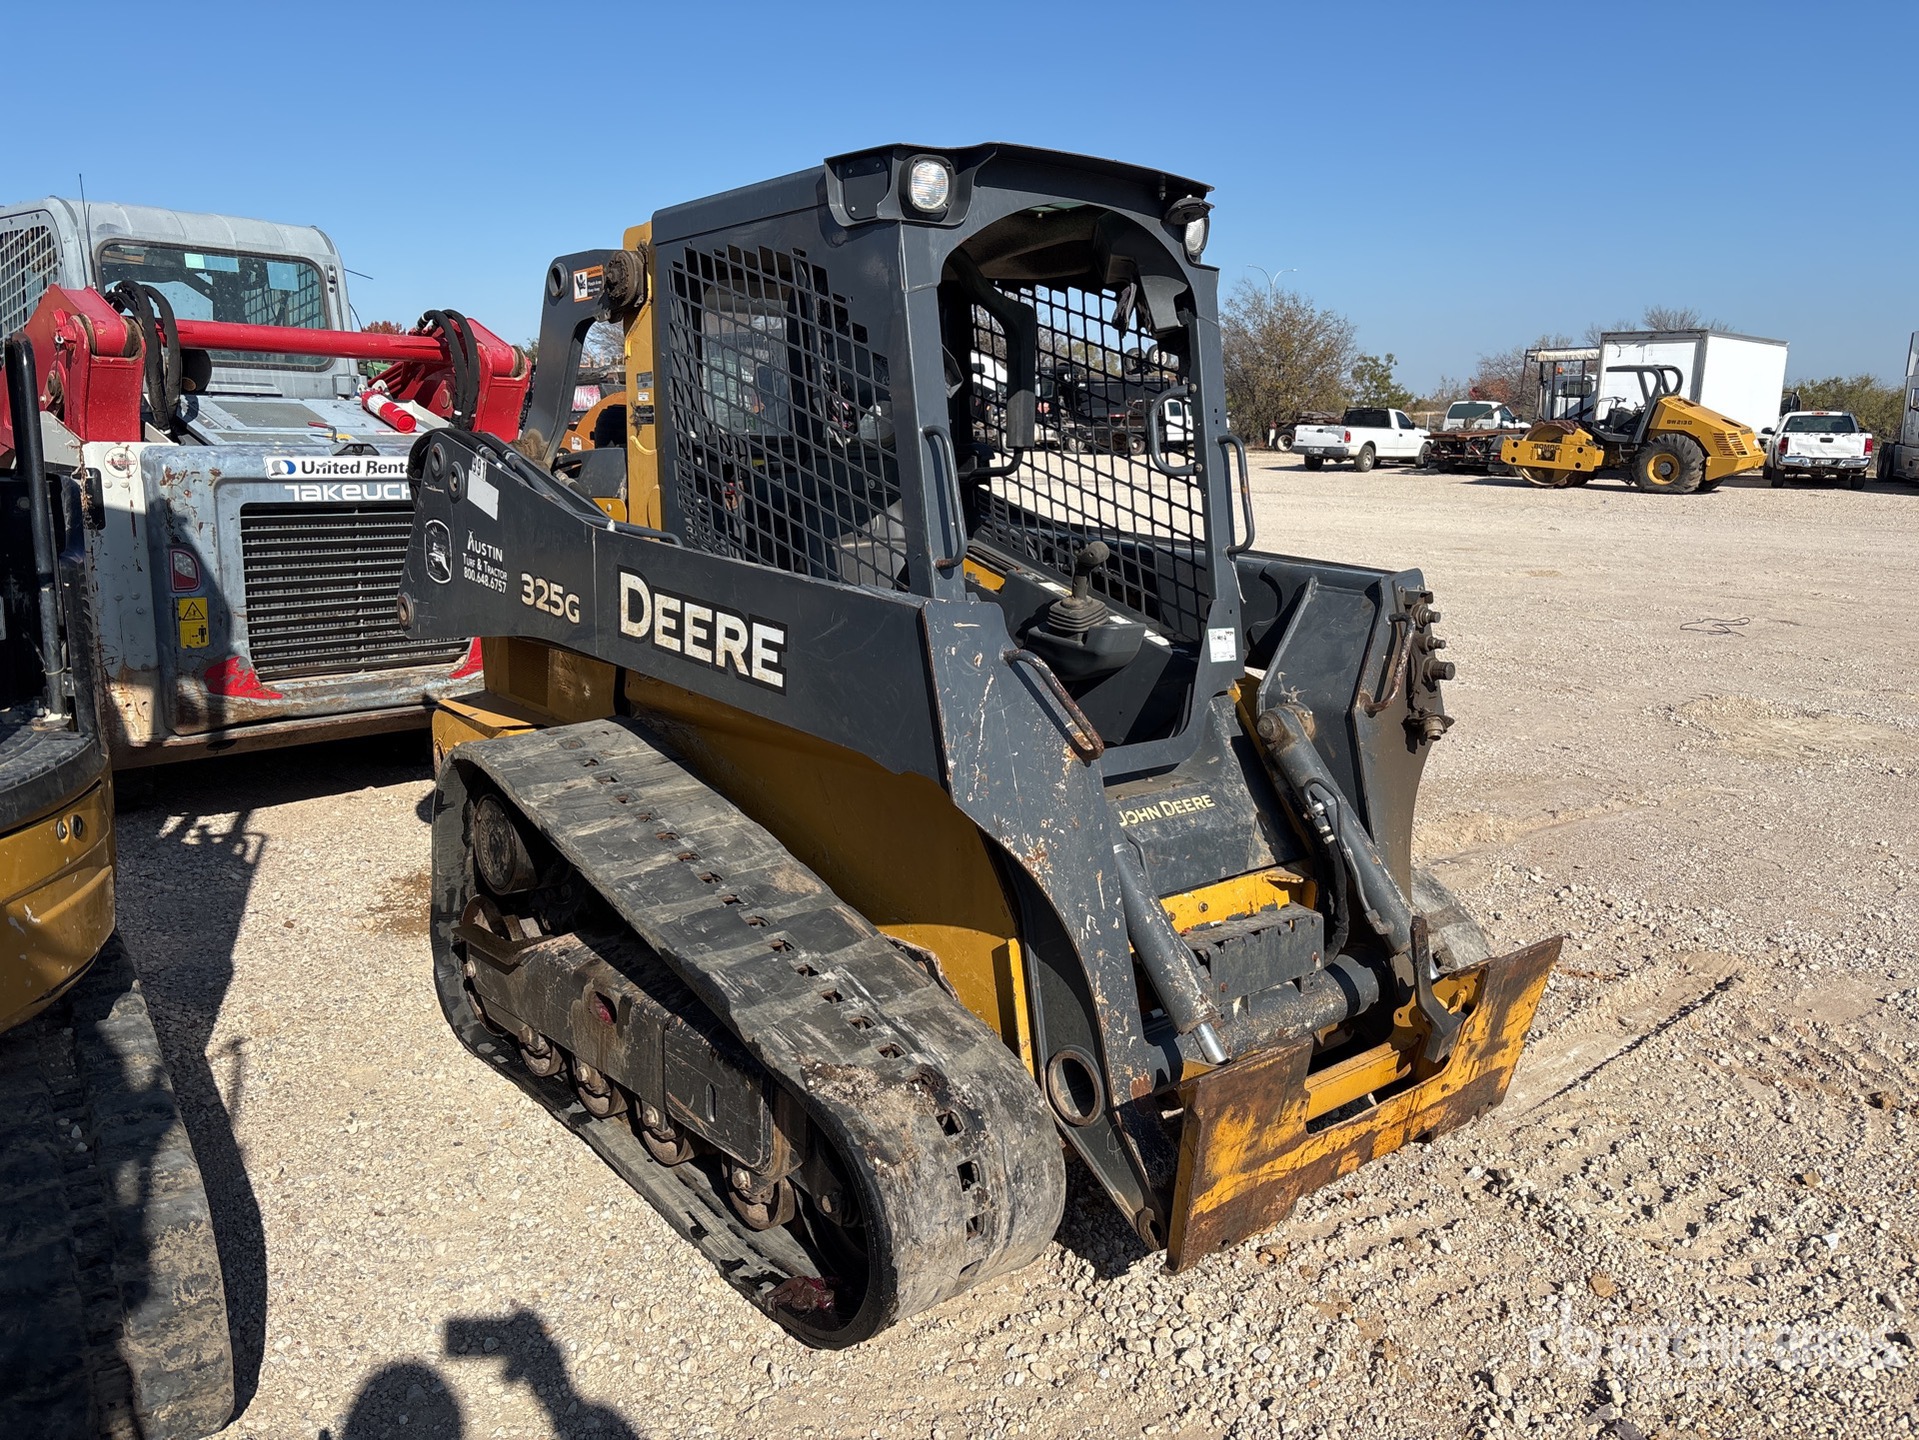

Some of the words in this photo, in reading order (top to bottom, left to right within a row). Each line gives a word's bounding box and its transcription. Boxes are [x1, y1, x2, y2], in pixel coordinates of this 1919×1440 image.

[301, 460, 361, 475] United
[466, 529, 503, 562] AUSTIN
[463, 566, 507, 594] 800.648.6757
[476, 557, 483, 571] &
[483, 560, 508, 581] TRACTOR
[521, 573, 580, 624] 325G
[619, 571, 785, 688] DEERE
[1118, 805, 1163, 827] JOHN
[1158, 794, 1216, 817] DEERE
